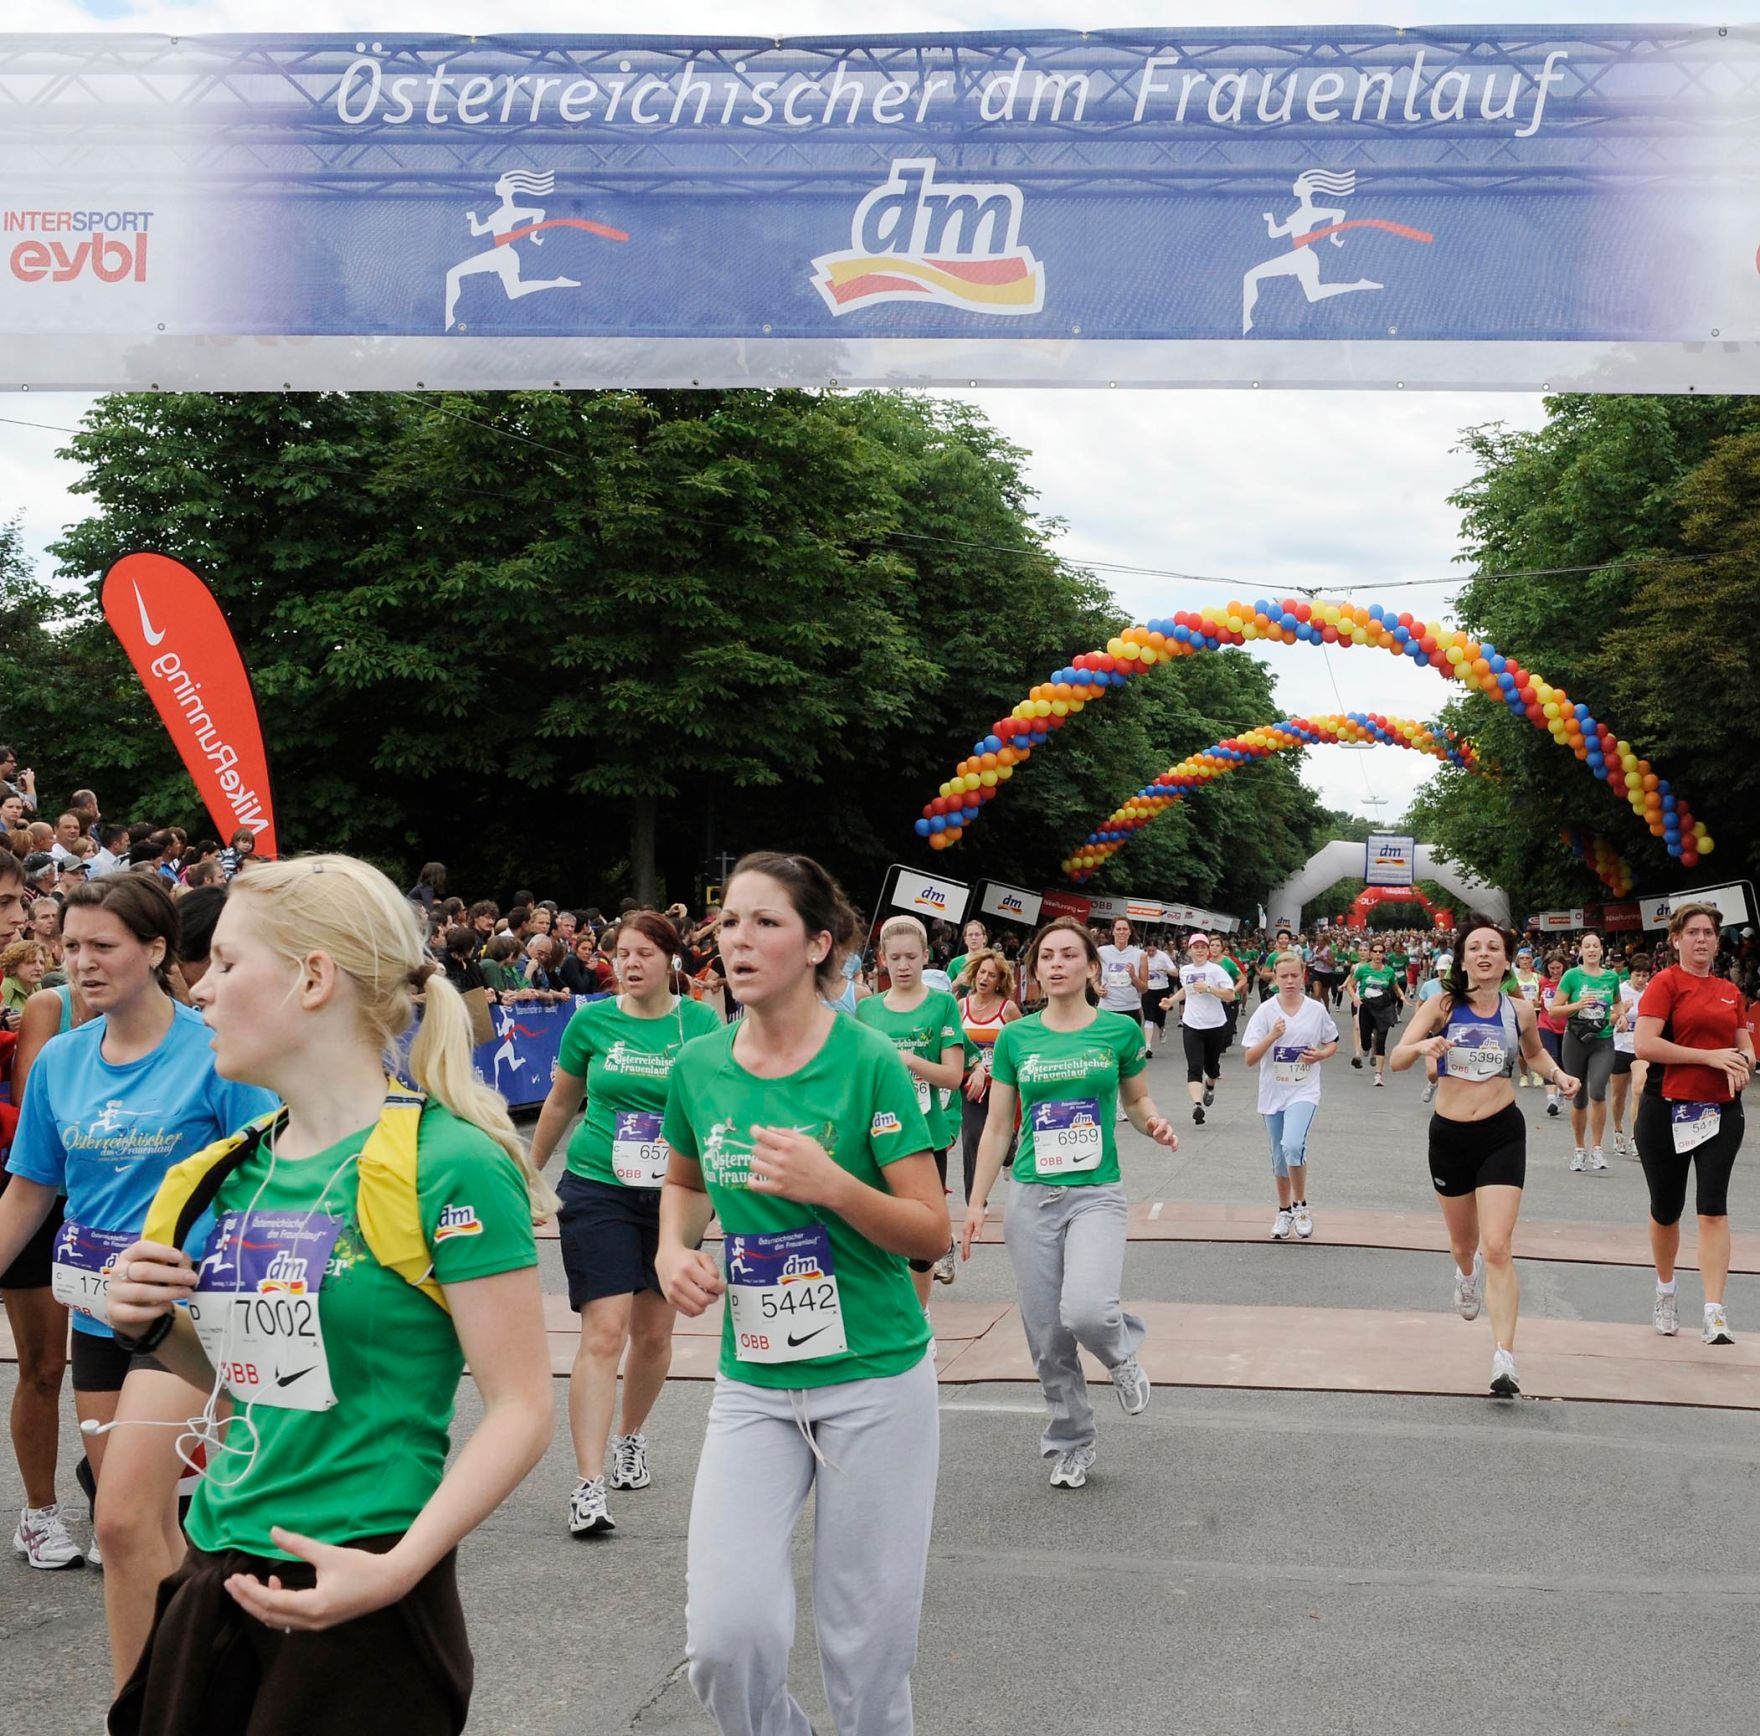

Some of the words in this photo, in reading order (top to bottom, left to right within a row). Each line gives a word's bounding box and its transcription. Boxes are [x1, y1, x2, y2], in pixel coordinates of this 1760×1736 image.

[336, 41, 949, 127] Österreichischer
[979, 56, 1089, 123] dm
[1132, 49, 1569, 138] Frauenlauf
[861, 167, 1013, 255] dm
[4, 211, 154, 232] INTERSPORT
[10, 232, 148, 283] eybl
[1379, 845, 1402, 858] dm
[921, 886, 946, 903] dm
[1002, 894, 1022, 909] dm
[1469, 1051, 1503, 1065] 5396
[873, 1113, 896, 1128] dm
[1058, 1128, 1099, 1146] 6959
[639, 1144, 670, 1161] 657
[440, 1207, 471, 1227] dm
[269, 1253, 305, 1280] dm
[785, 1257, 816, 1276] dm
[762, 1283, 837, 1318] 5442
[235, 1299, 316, 1338] 7002
